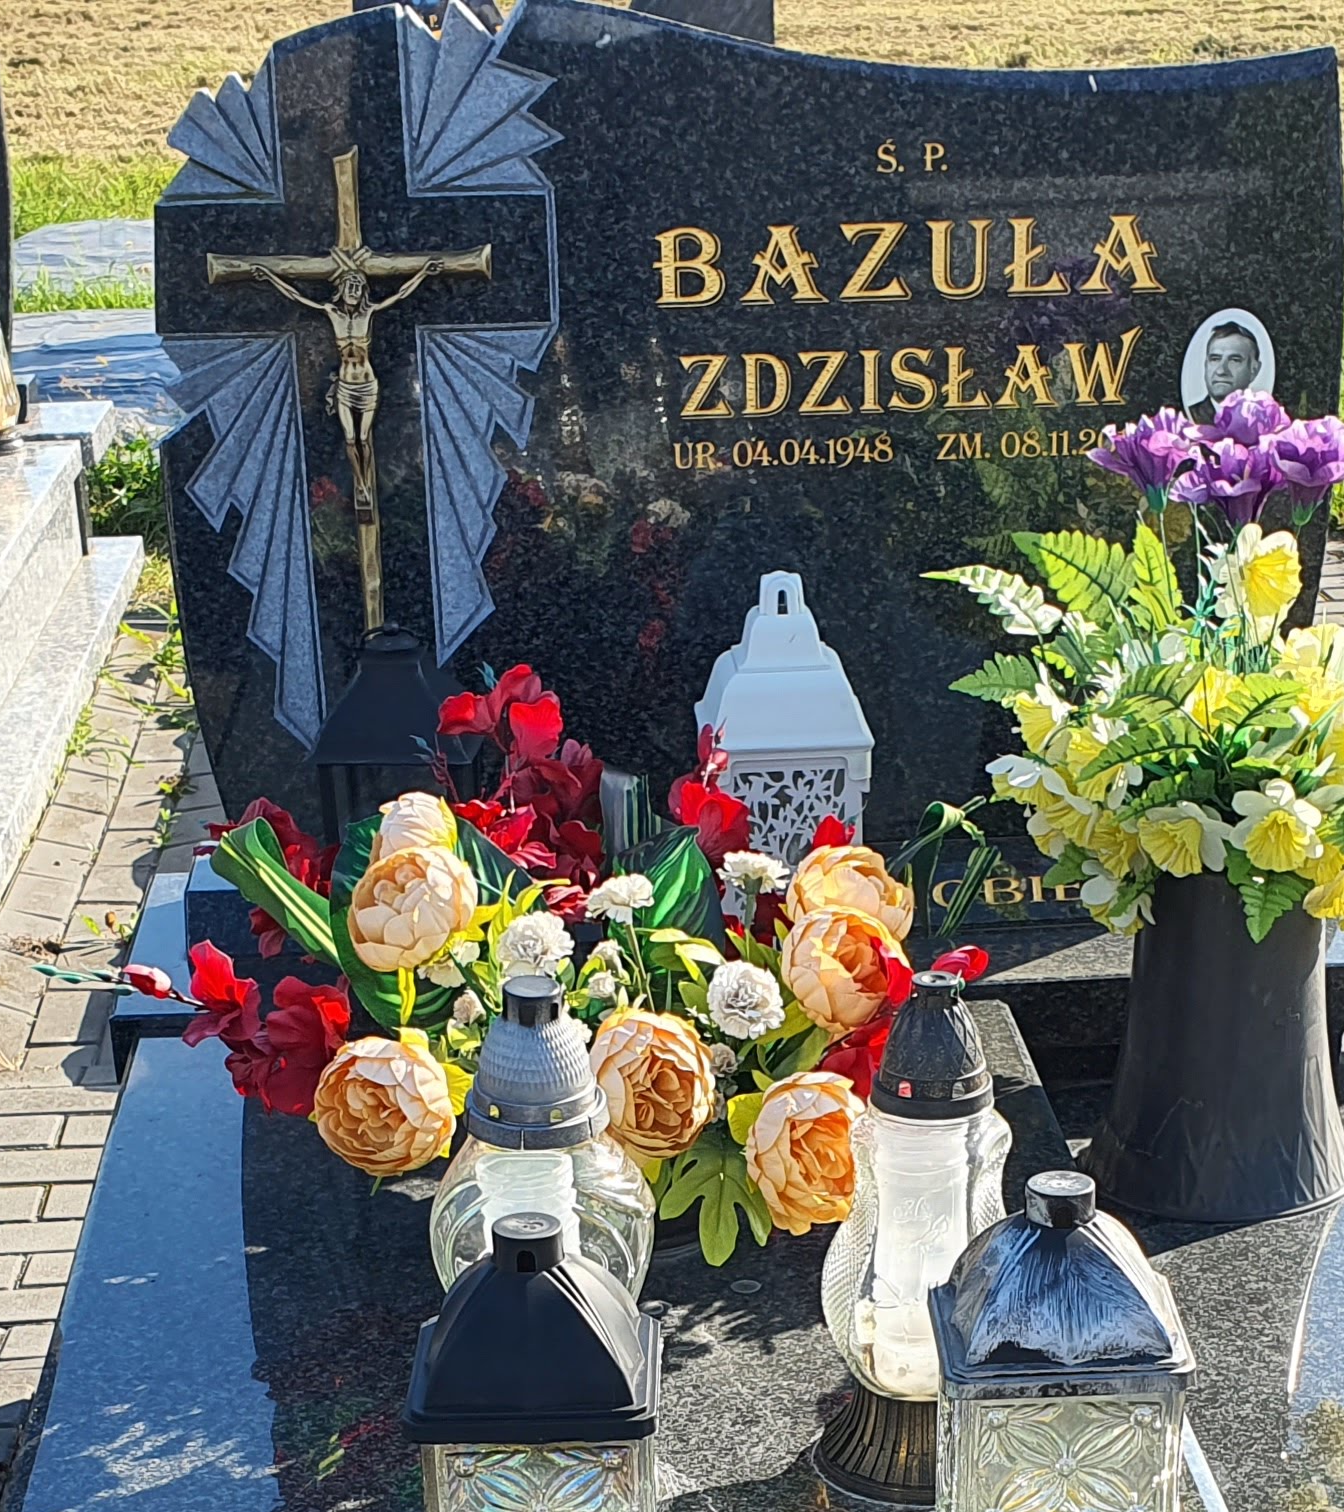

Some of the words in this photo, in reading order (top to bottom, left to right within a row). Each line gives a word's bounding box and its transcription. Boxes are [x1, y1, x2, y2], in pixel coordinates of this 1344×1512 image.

[653, 214, 1168, 309] BAZUŁA
[679, 326, 1143, 420] ZDZISŁAW
[672, 441, 723, 472] UR.
[732, 430, 895, 467] 04.04.1948
[935, 432, 991, 461] ZM.
